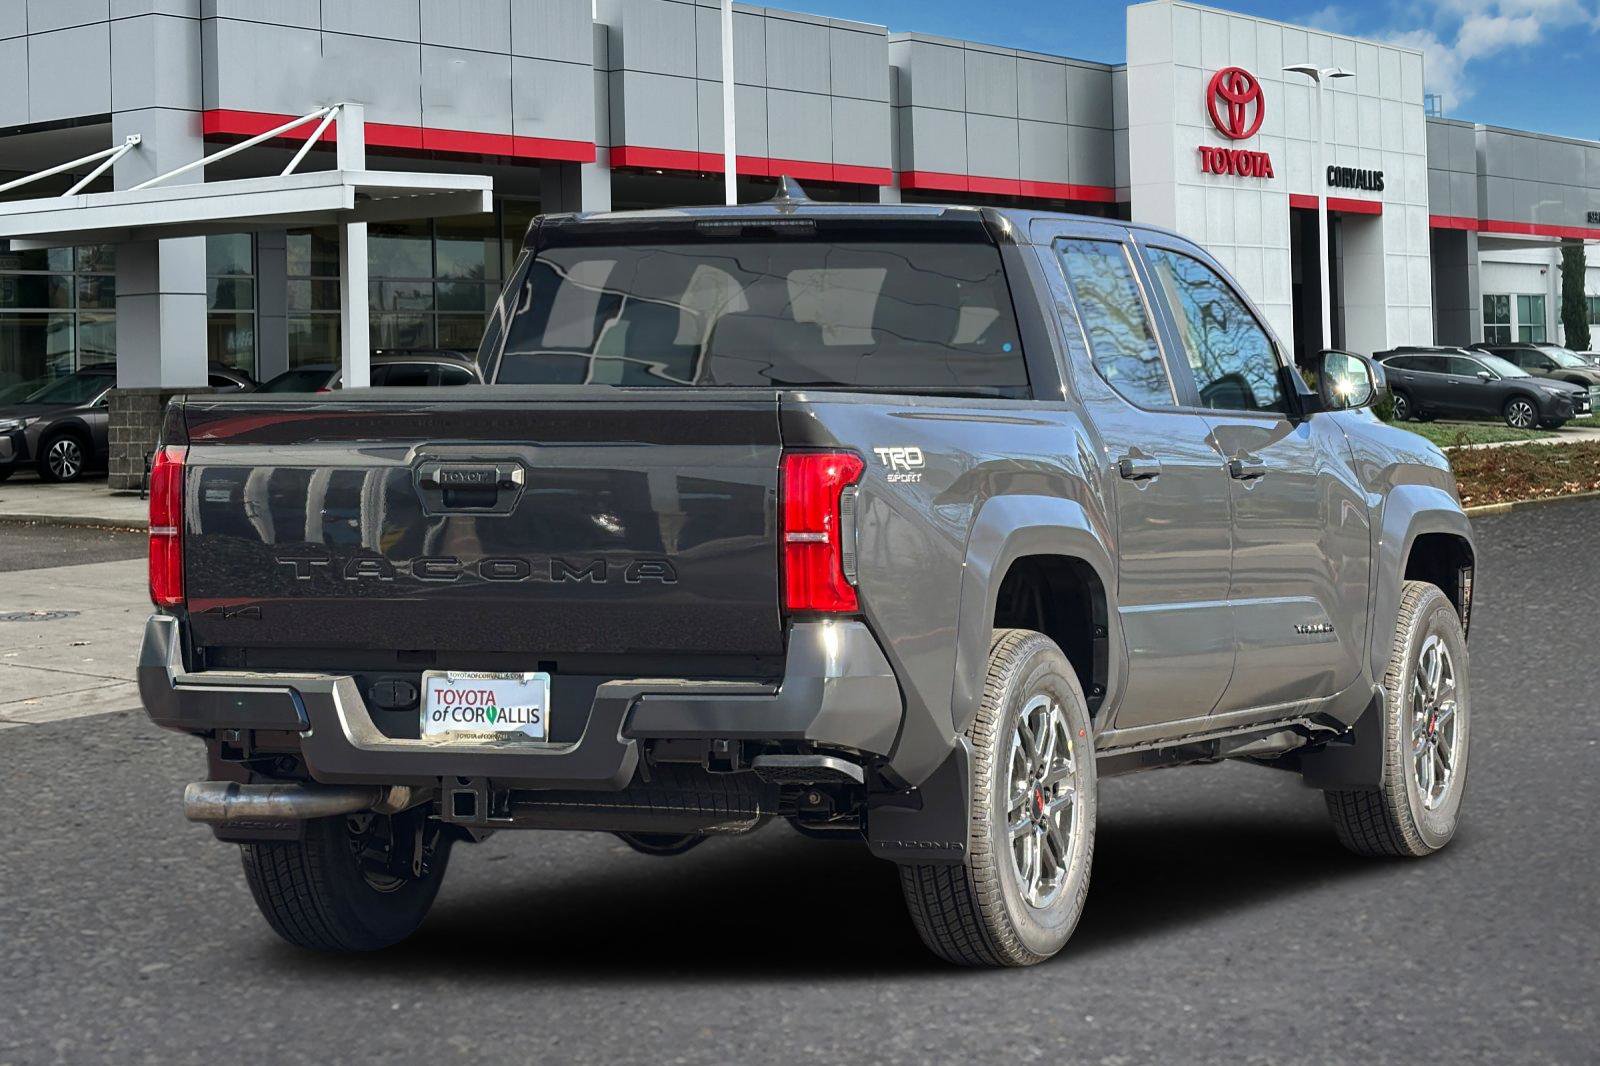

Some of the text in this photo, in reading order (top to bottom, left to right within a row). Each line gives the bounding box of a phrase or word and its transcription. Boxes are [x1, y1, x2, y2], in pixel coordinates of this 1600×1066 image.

[1199, 146, 1274, 178] TOYOTA
[1326, 165, 1384, 191] CORVALLIS
[873, 447, 924, 470] TRD
[887, 473, 921, 482] SPORT
[275, 556, 678, 584] TACOMA
[434, 689, 496, 706] TOYOTA
[432, 706, 540, 726] of CORVALLIS
